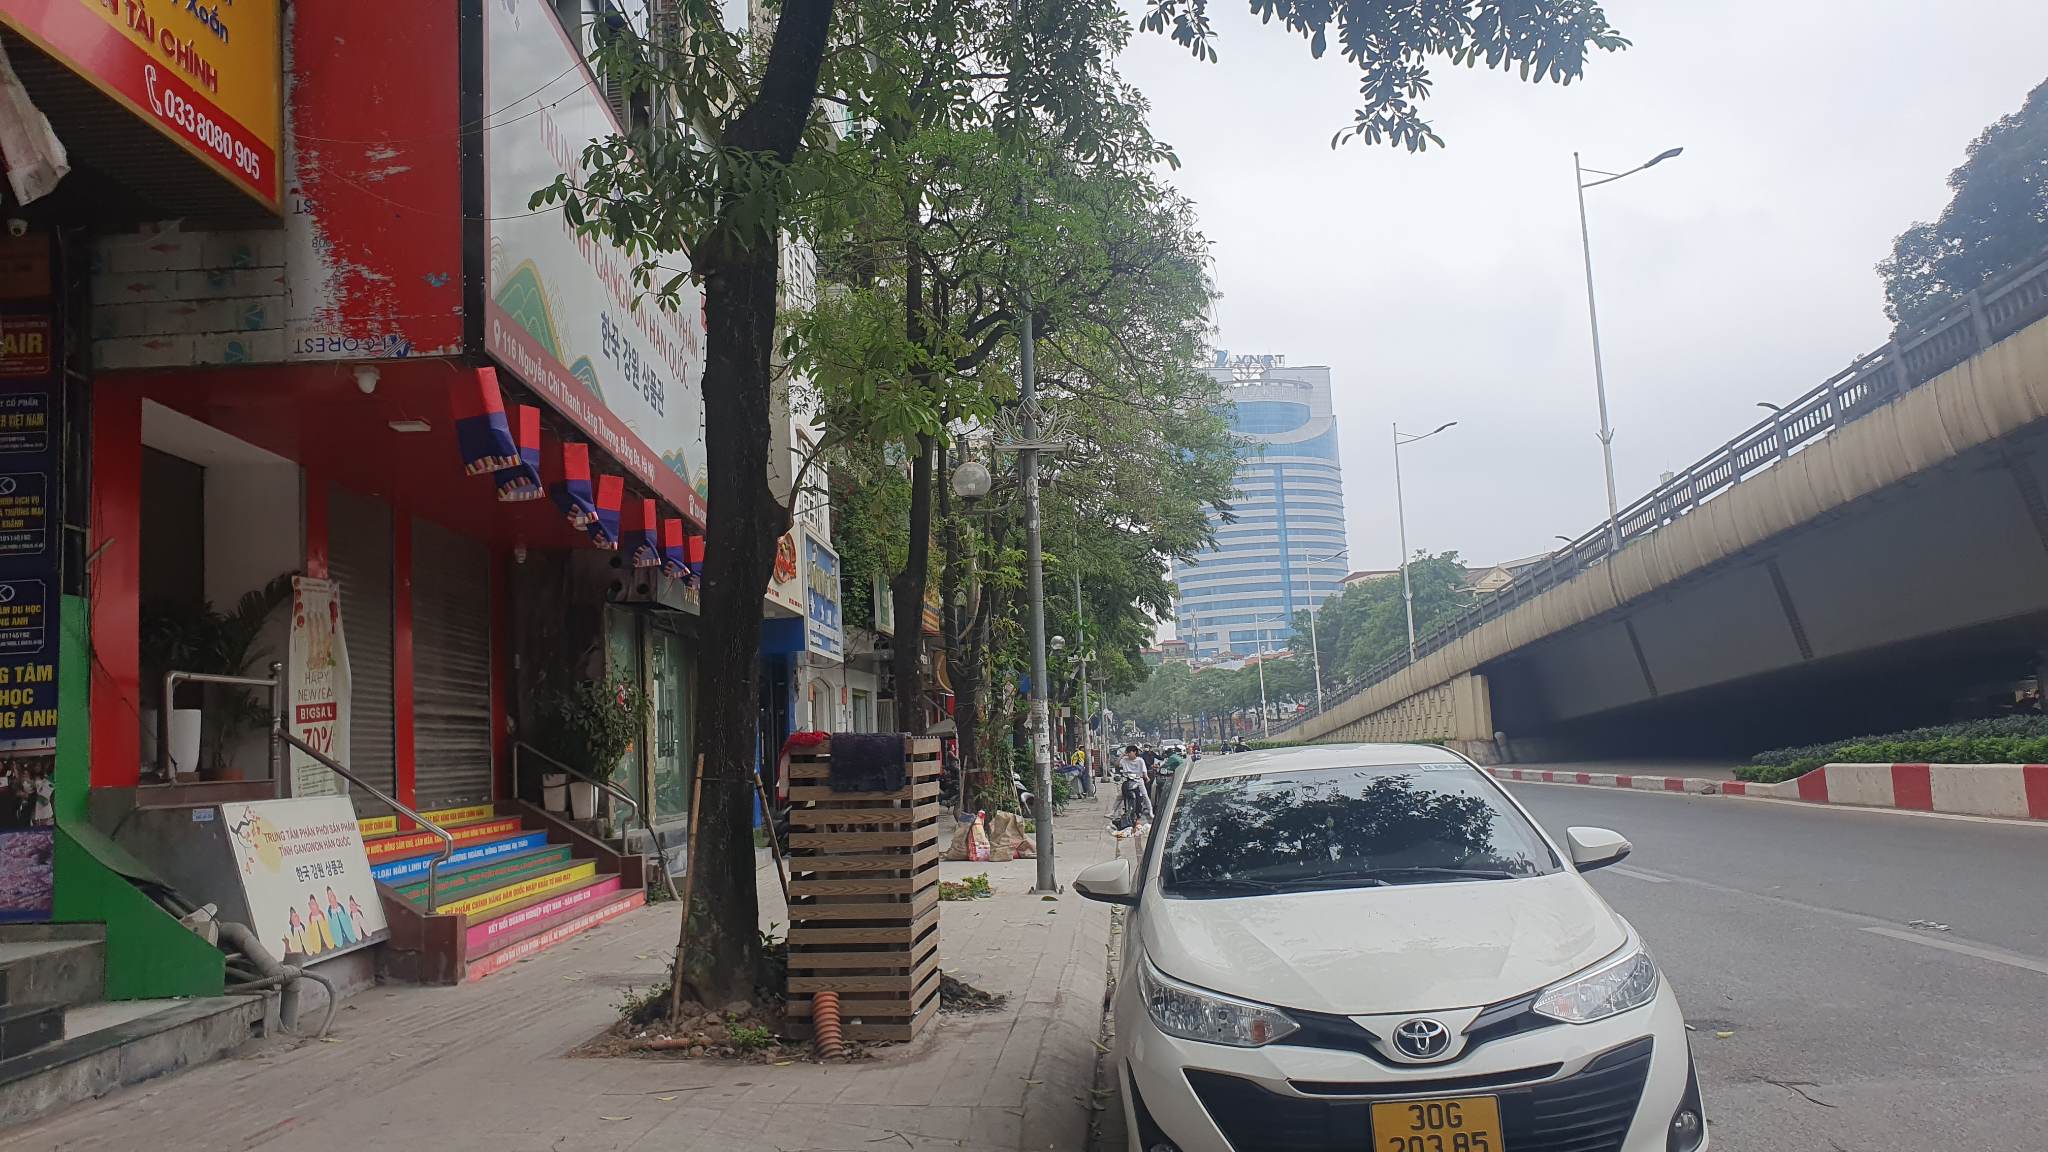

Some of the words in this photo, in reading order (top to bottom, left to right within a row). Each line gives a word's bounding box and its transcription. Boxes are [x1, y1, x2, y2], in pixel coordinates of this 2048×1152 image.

[159, 28, 218, 94] CHÍNH
[164, 89, 195, 133] 033
[196, 112, 232, 160] 8080
[234, 140, 260, 180] 905
[649, 313, 667, 363] HÀN
[668, 342, 689, 392] QUỐC
[502, 331, 517, 358] 116
[518, 345, 547, 387] Nguyễn
[547, 370, 560, 398] Chí
[560, 380, 583, 420] Thanh,
[600, 311, 620, 371] 한국
[622, 336, 640, 391] 강원
[642, 361, 665, 418] 상품관
[15, 662, 54, 684] TÂM
[0, 687, 34, 708] HỌC
[21, 709, 57, 728] ANH
[264, 831, 286, 844] TRUNG
[285, 828, 300, 840] TÂM
[299, 825, 316, 839] PHÂN
[293, 839, 324, 855] GANGWON
[324, 836, 336, 849] HÀN
[336, 835, 351, 847] QUỐC
[295, 865, 310, 882] 한국
[310, 863, 325, 880] 강원
[325, 859, 345, 877] 상품관
[377, 867, 392, 880] LOẠI
[408, 862, 422, 873] LINH
[513, 887, 526, 900] QUỐC
[488, 923, 498, 934] KẾT
[543, 903, 552, 914] VIỆT
[1408, 1102, 1463, 1130] 30G
